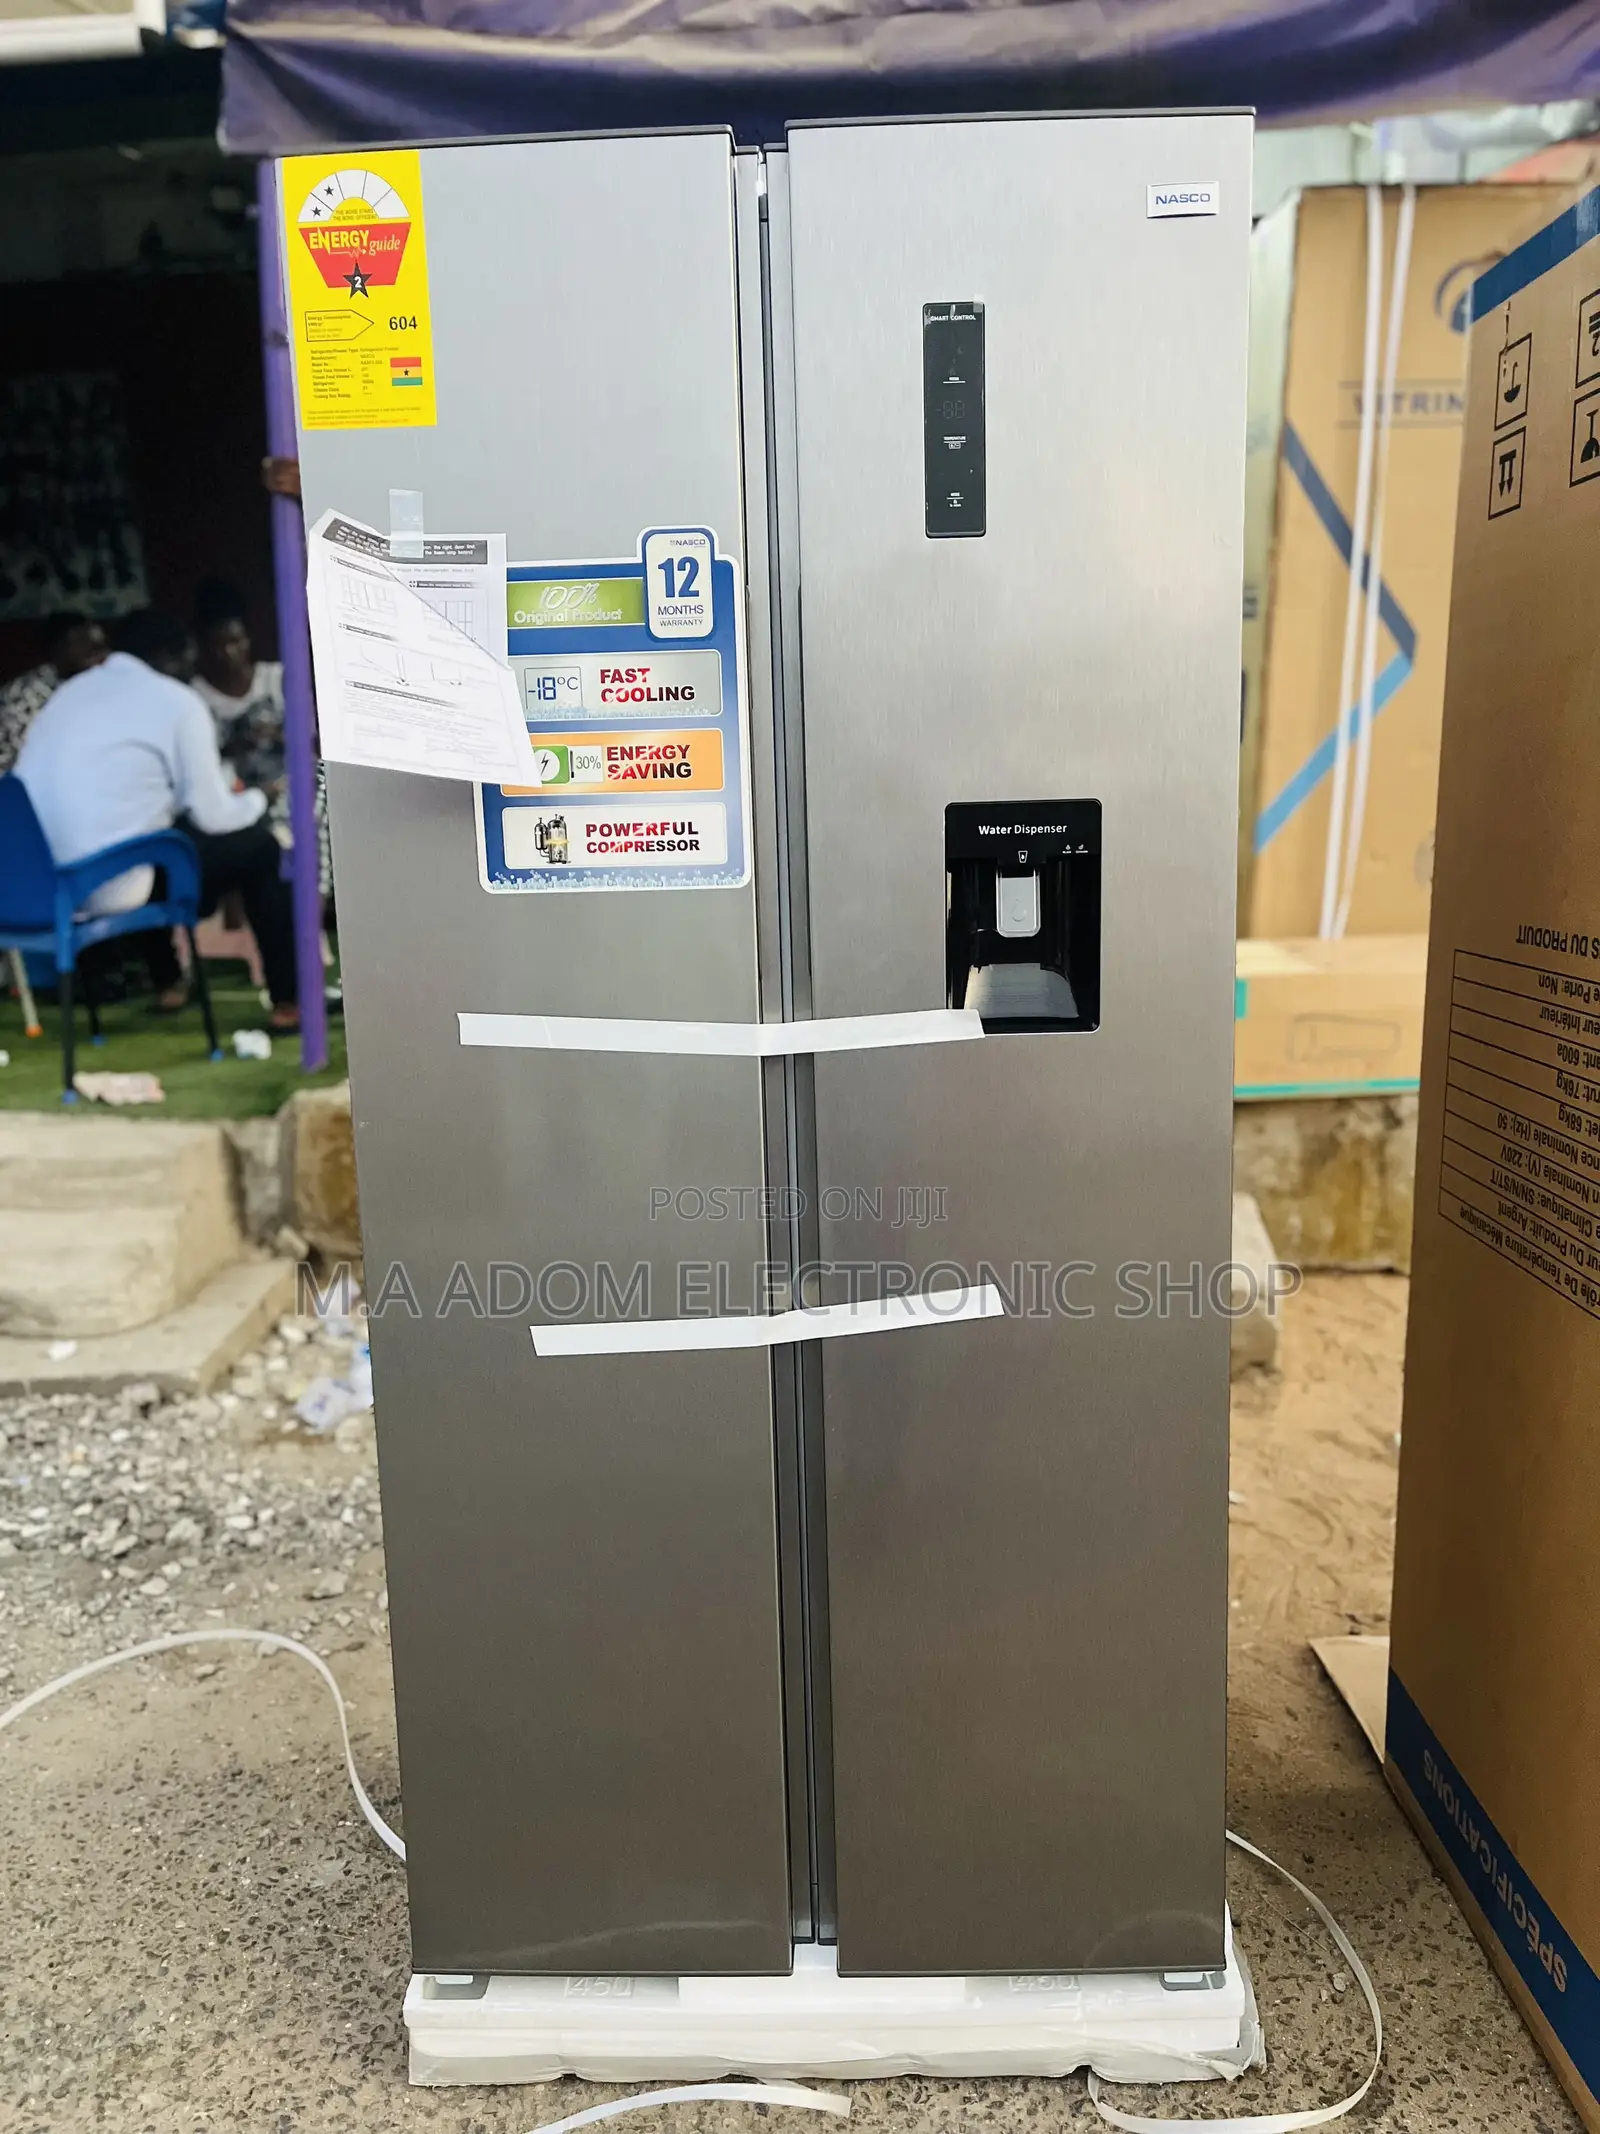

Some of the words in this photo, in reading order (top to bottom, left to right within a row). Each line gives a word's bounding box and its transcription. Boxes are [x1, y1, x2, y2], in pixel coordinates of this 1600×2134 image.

[1155, 193, 1211, 205] NASCO
[309, 228, 369, 254] ENERGY
[368, 234, 400, 256] guide
[354, 276, 362, 288] 2
[389, 315, 417, 330] 604
[657, 556, 700, 598] 12
[539, 582, 600, 609] 100%
[513, 610, 568, 626] Original
[573, 608, 623, 622] Product
[657, 604, 704, 616] MONTHS
[659, 618, 703, 627] WARRANTY
[600, 667, 651, 684] FAST
[600, 685, 695, 703] COOLING
[576, 756, 601, 770] 30%
[606, 744, 691, 761] ENERGY
[607, 762, 692, 780] SAVING
[586, 821, 699, 838] POWERFUL
[978, 824, 1012, 835] Water
[1014, 823, 1067, 836] Dispenser
[586, 839, 700, 854] COMPRESSOR
[1516, 924, 1568, 953] PRODUIT
[1570, 933, 1589, 957] DU
[1538, 974, 1559, 996] Non
[1561, 979, 1591, 1004] Porte:
[1539, 1005, 1582, 1035] Intérieur
[1556, 1042, 1580, 1066] 600a
[1556, 1071, 1581, 1100] 76kg
[1497, 1112, 1508, 1131] 50
[1510, 1114, 1532, 1141] (Hz):
[1558, 1104, 1583, 1133] 68kg
[1500, 1144, 1523, 1168] 220V
[1533, 1128, 1579, 1164] Nominale
[1524, 1151, 1541, 1177] (V):
[1543, 1164, 1590, 1204] Nominale
[1497, 1200, 1528, 1231] Argent
[1537, 1194, 1593, 1238] Climatique:
[1529, 1217, 1568, 1257] Produit:
[1504, 1235, 1562, 1286] Température
[1569, 1244, 1584, 1267] Du
[1564, 1271, 1578, 1296] De
